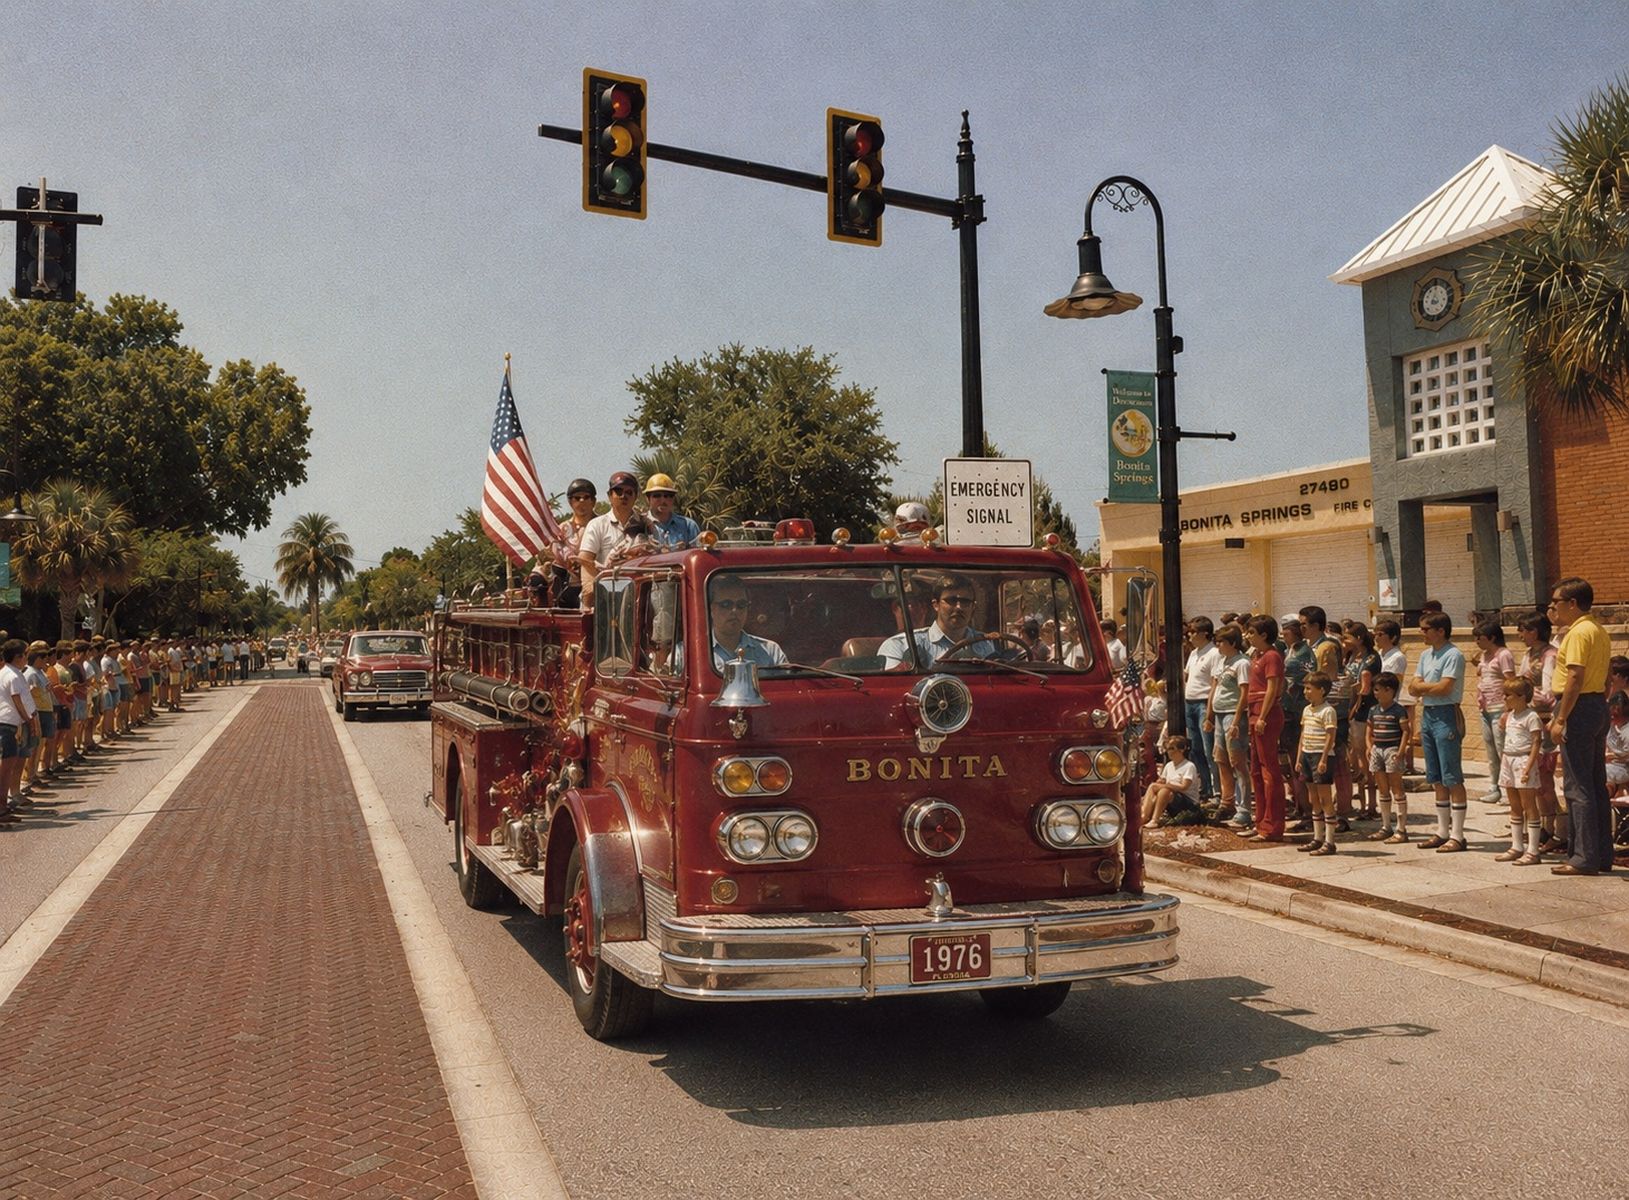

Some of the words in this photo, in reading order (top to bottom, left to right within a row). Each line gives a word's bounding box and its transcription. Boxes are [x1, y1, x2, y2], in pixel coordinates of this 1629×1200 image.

[1116, 459, 1152, 471] Bonita
[1113, 471, 1154, 485] Springs
[1299, 477, 1350, 496] 27480
[951, 482, 1025, 497] EMERGENCY
[966, 508, 1013, 524] SIGNAL
[1180, 513, 1232, 531] BONITA
[1240, 503, 1313, 524] SPRINGS
[1333, 500, 1359, 513] FIRE
[846, 755, 1008, 782] BONITA
[923, 943, 982, 973] 1976
